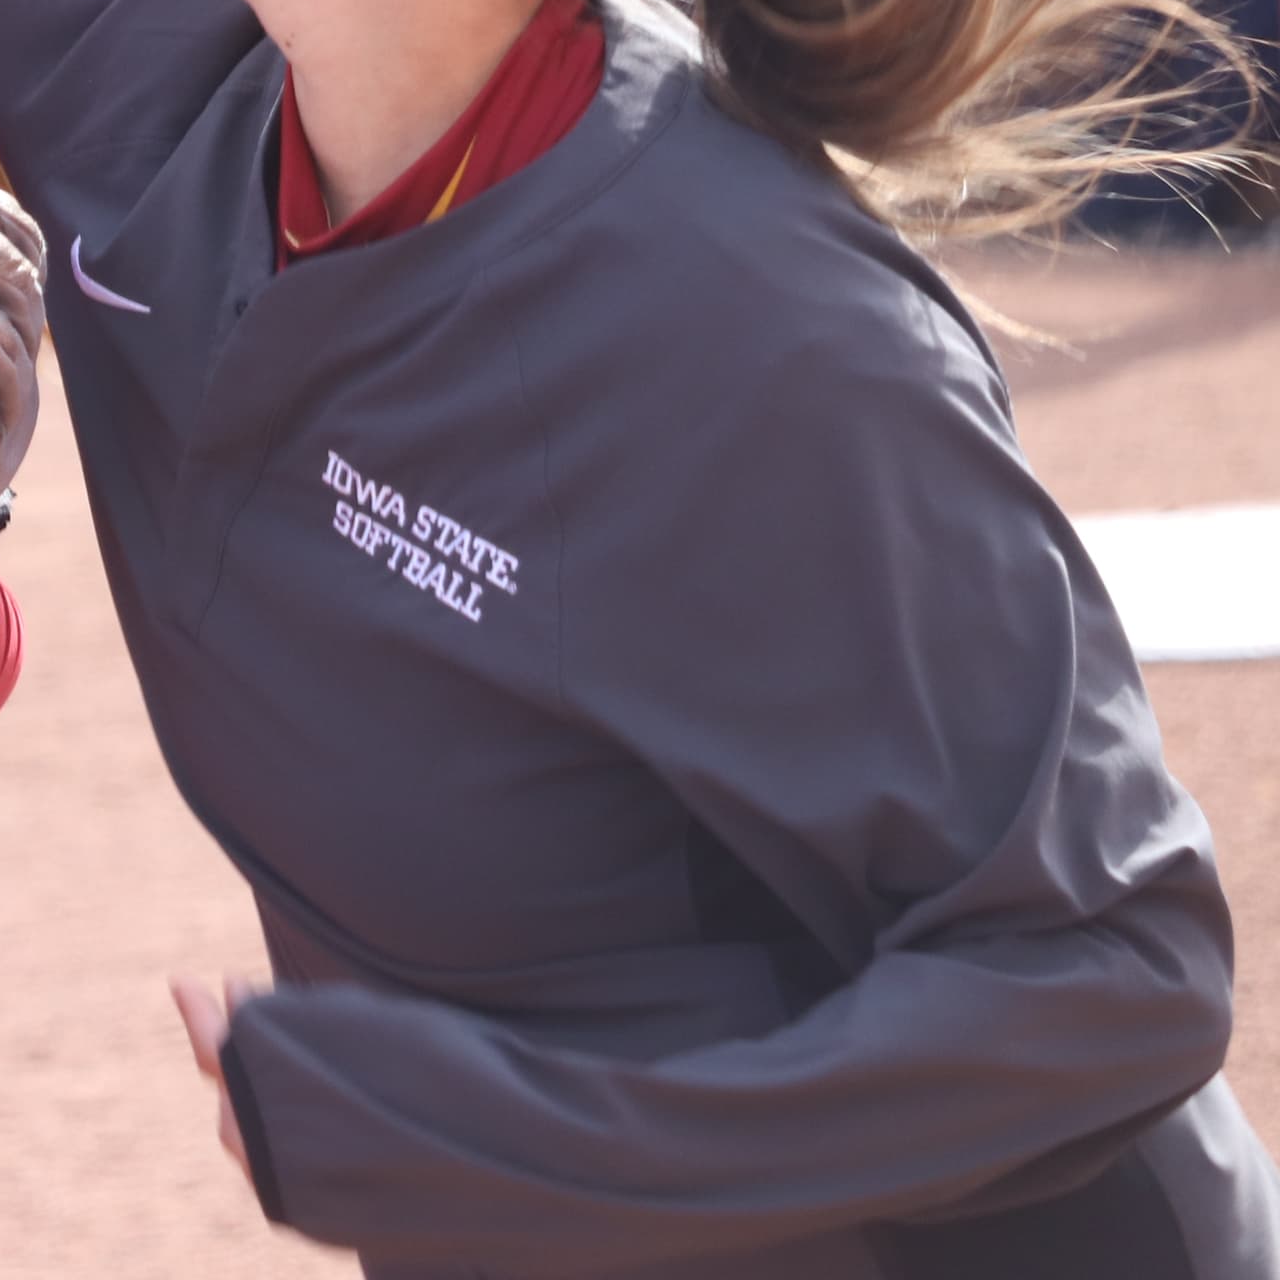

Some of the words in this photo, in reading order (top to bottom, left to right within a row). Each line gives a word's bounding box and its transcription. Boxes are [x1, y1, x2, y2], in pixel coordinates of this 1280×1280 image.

[322, 449, 406, 528] IOWA
[411, 504, 519, 592] STATE
[333, 500, 483, 623] SOFTBALL
